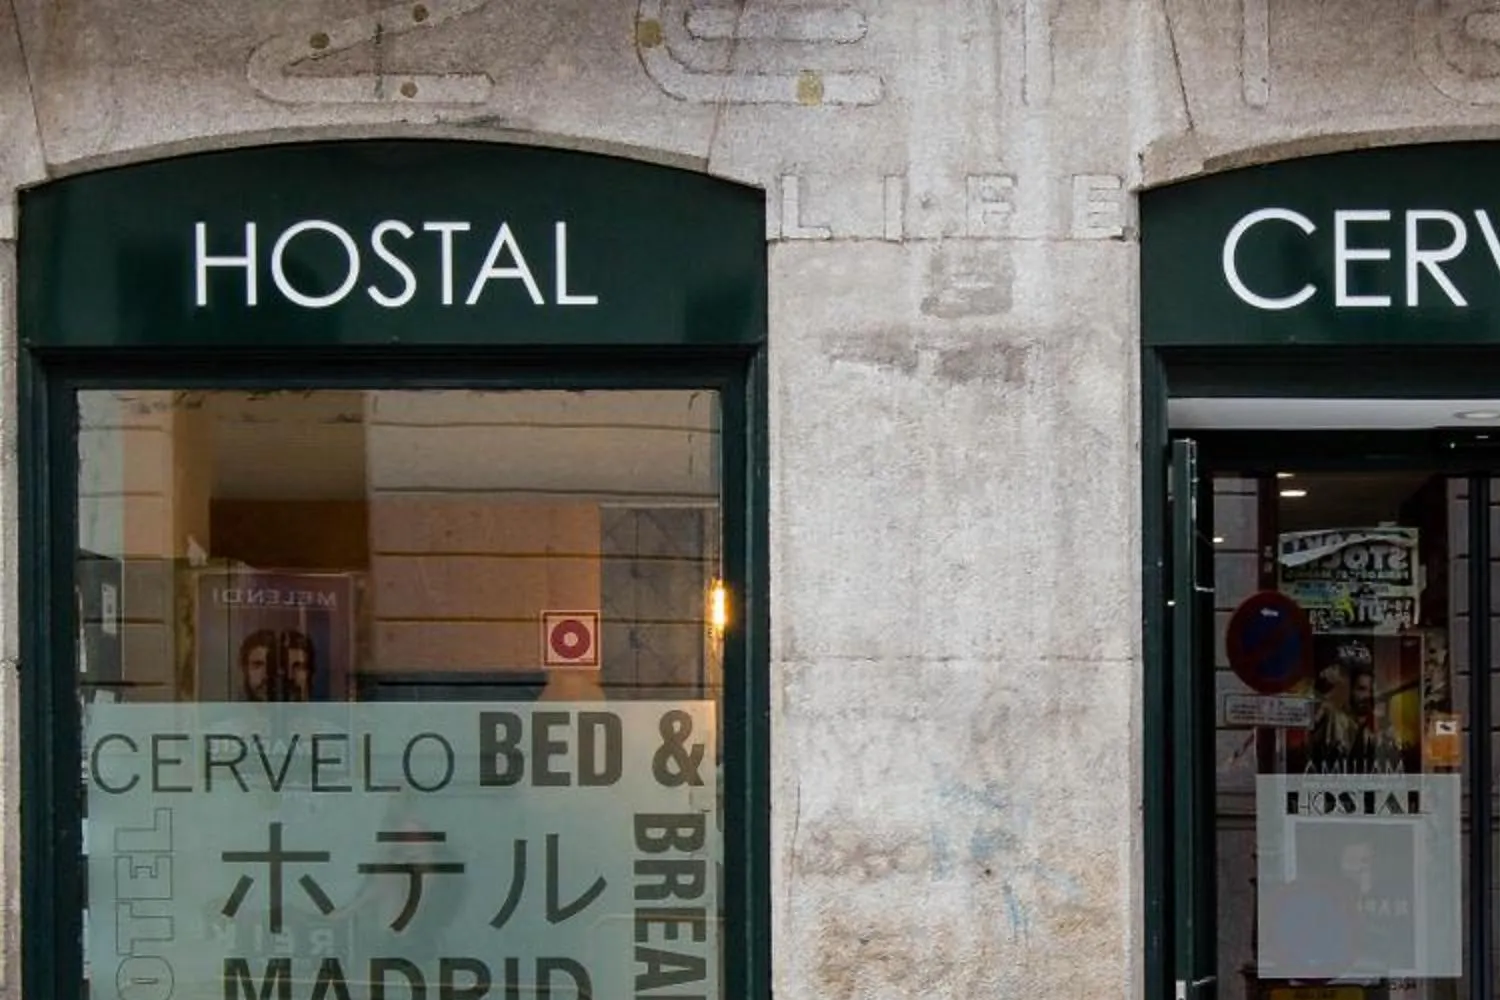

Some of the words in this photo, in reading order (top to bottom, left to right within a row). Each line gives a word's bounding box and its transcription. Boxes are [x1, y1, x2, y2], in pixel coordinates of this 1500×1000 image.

[194, 219, 599, 308] HOSTAL
[91, 732, 455, 794] CERVELO
[479, 711, 623, 787] BED
[651, 709, 706, 788] &
[1286, 790, 1432, 816] HOSTAL
[221, 822, 607, 935] ホテル
